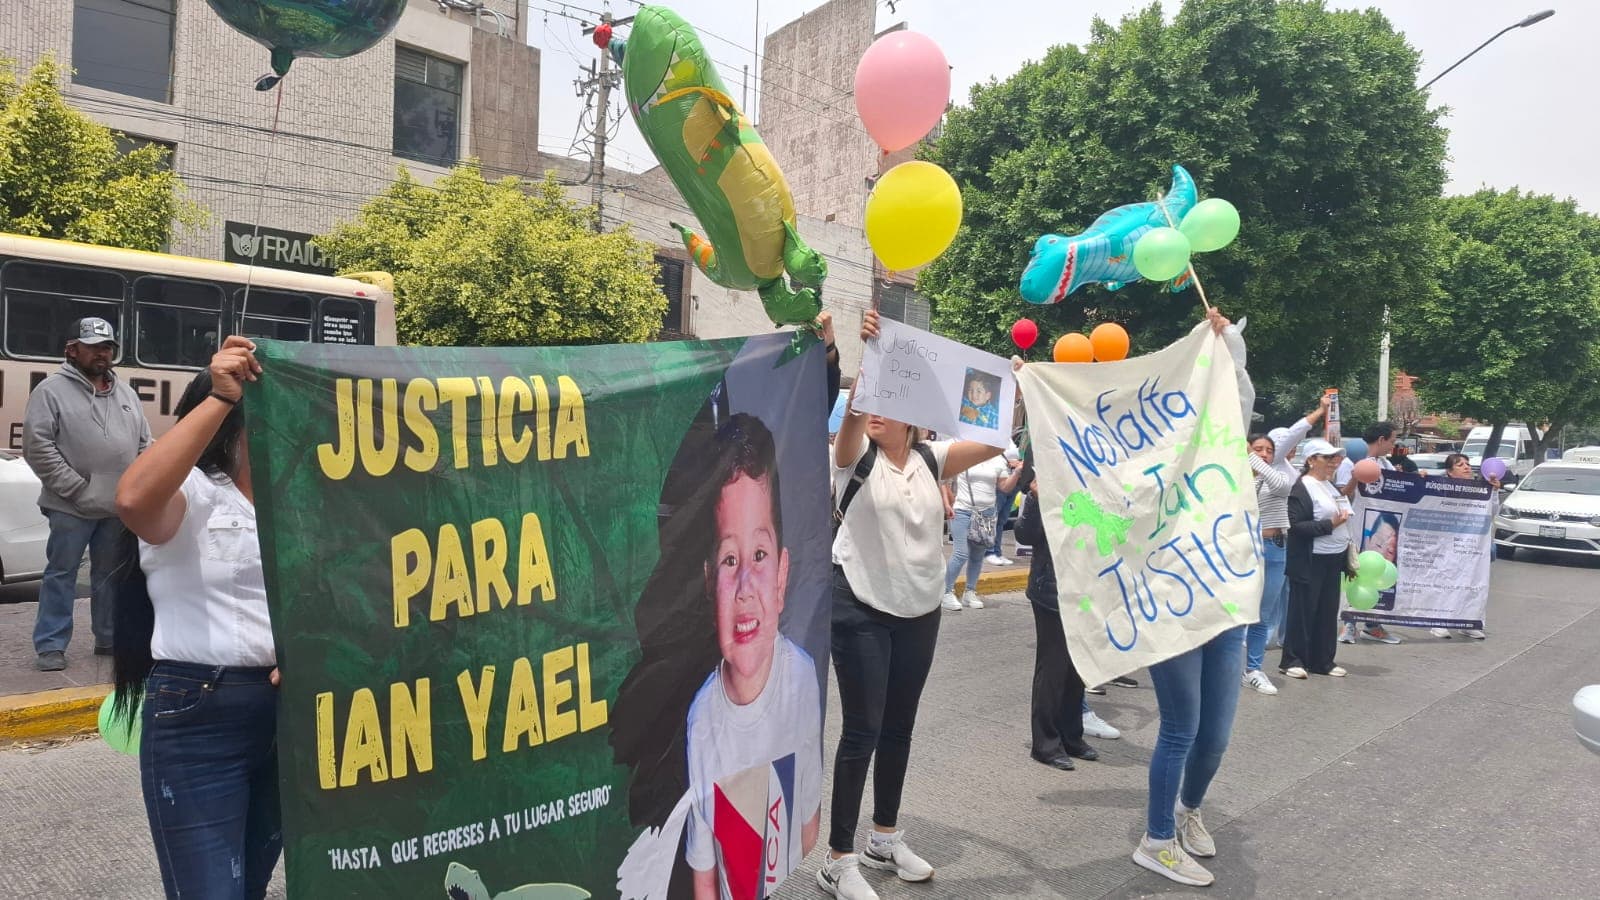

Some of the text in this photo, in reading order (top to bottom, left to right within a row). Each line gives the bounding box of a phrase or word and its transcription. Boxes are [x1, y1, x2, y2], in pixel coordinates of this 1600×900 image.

[316, 374, 591, 481] JUSTICIA
[1142, 463, 1240, 540] Ian
[390, 511, 557, 628] PARA
[315, 642, 609, 790] IAN YAEL
[391, 837, 418, 864] QUE
[423, 822, 484, 857] REGRESES
[489, 818, 500, 842] A
[504, 811, 520, 836] TU
[524, 799, 565, 830] LUGAR
